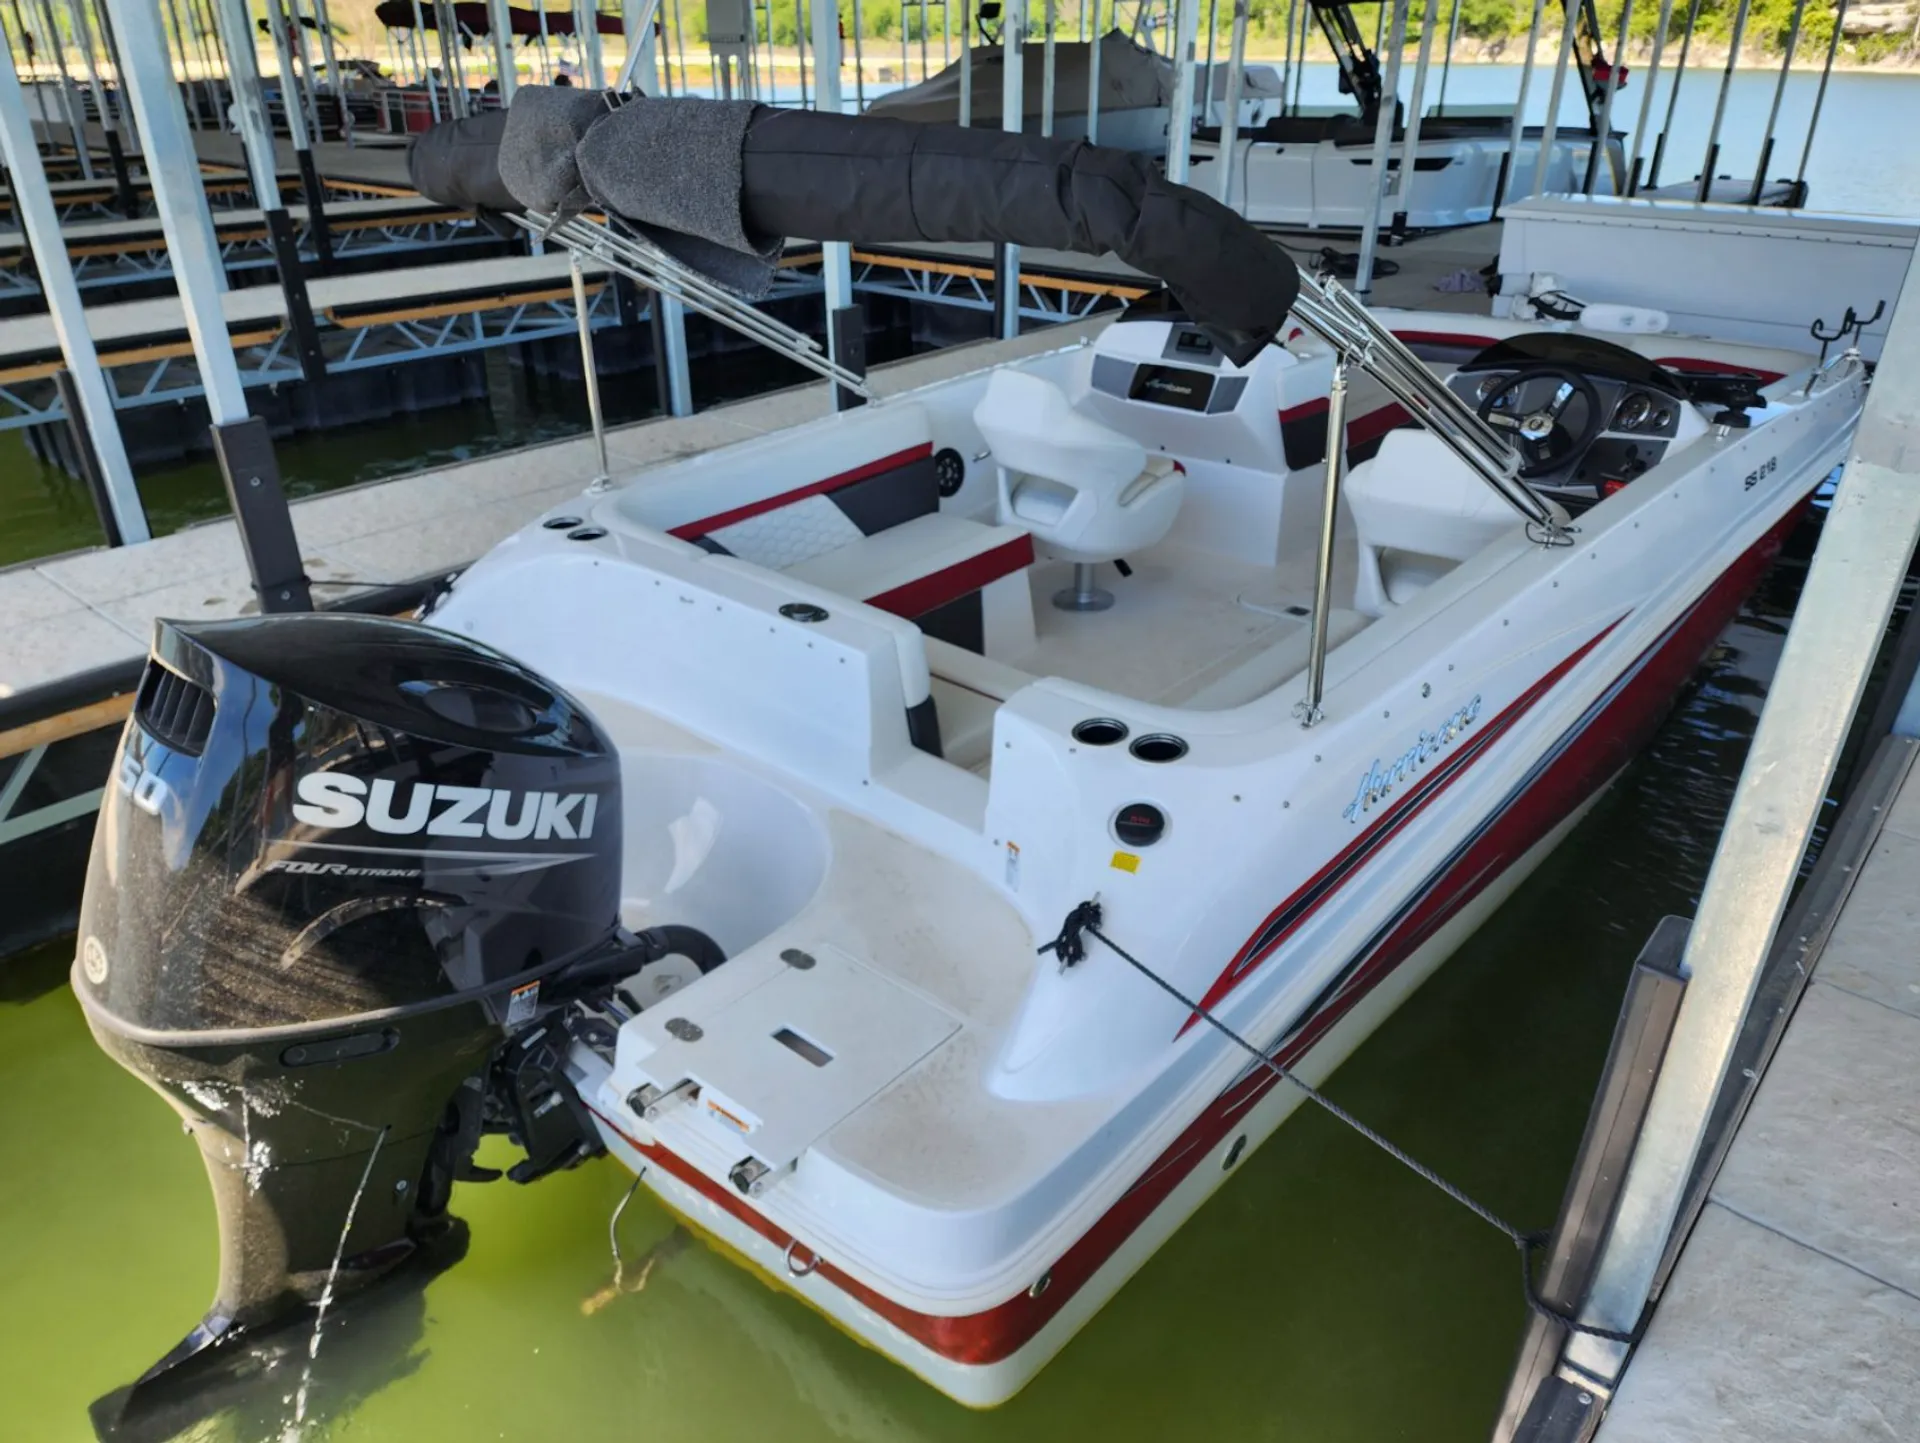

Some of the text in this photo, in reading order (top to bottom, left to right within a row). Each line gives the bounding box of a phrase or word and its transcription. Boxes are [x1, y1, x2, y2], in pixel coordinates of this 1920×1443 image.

[1744, 470, 1757, 491] SS
[1342, 694, 1481, 824] Hurricane
[292, 771, 598, 840] SUZUKI
[265, 860, 421, 877] FOUR STROKE
